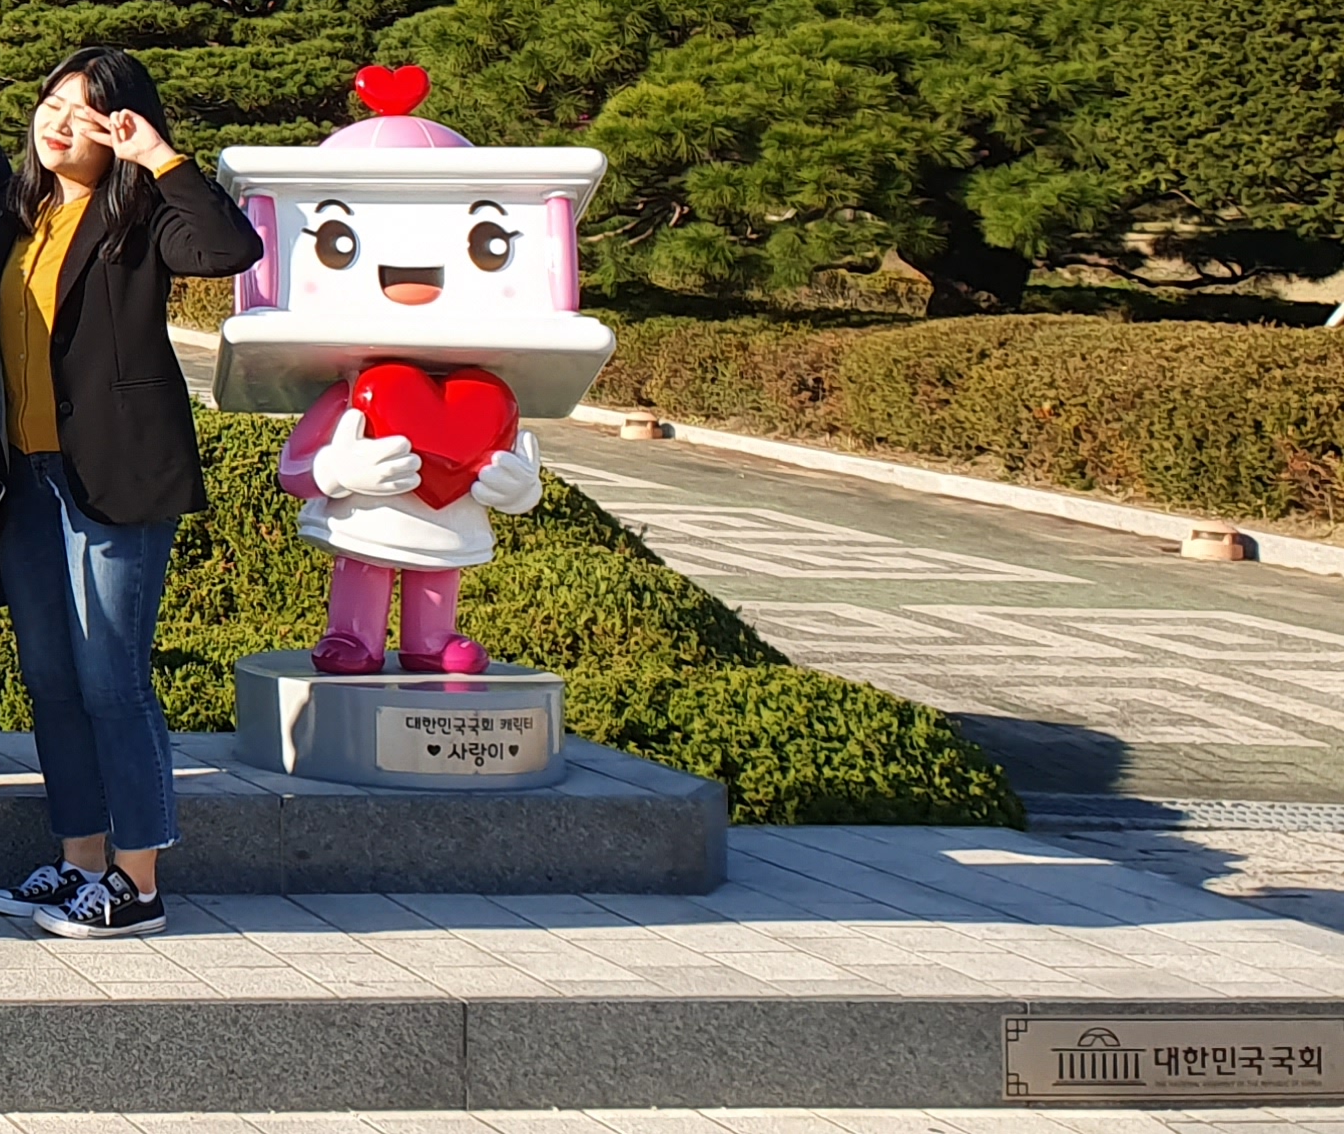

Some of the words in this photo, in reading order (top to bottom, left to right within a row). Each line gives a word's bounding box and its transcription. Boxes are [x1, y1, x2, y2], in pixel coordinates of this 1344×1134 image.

[405, 716, 494, 738] 대한민국국회
[499, 716, 534, 736] 캐릭터
[446, 741, 505, 767] 사랑이
[1153, 1045, 1323, 1077] 대한민국국회
